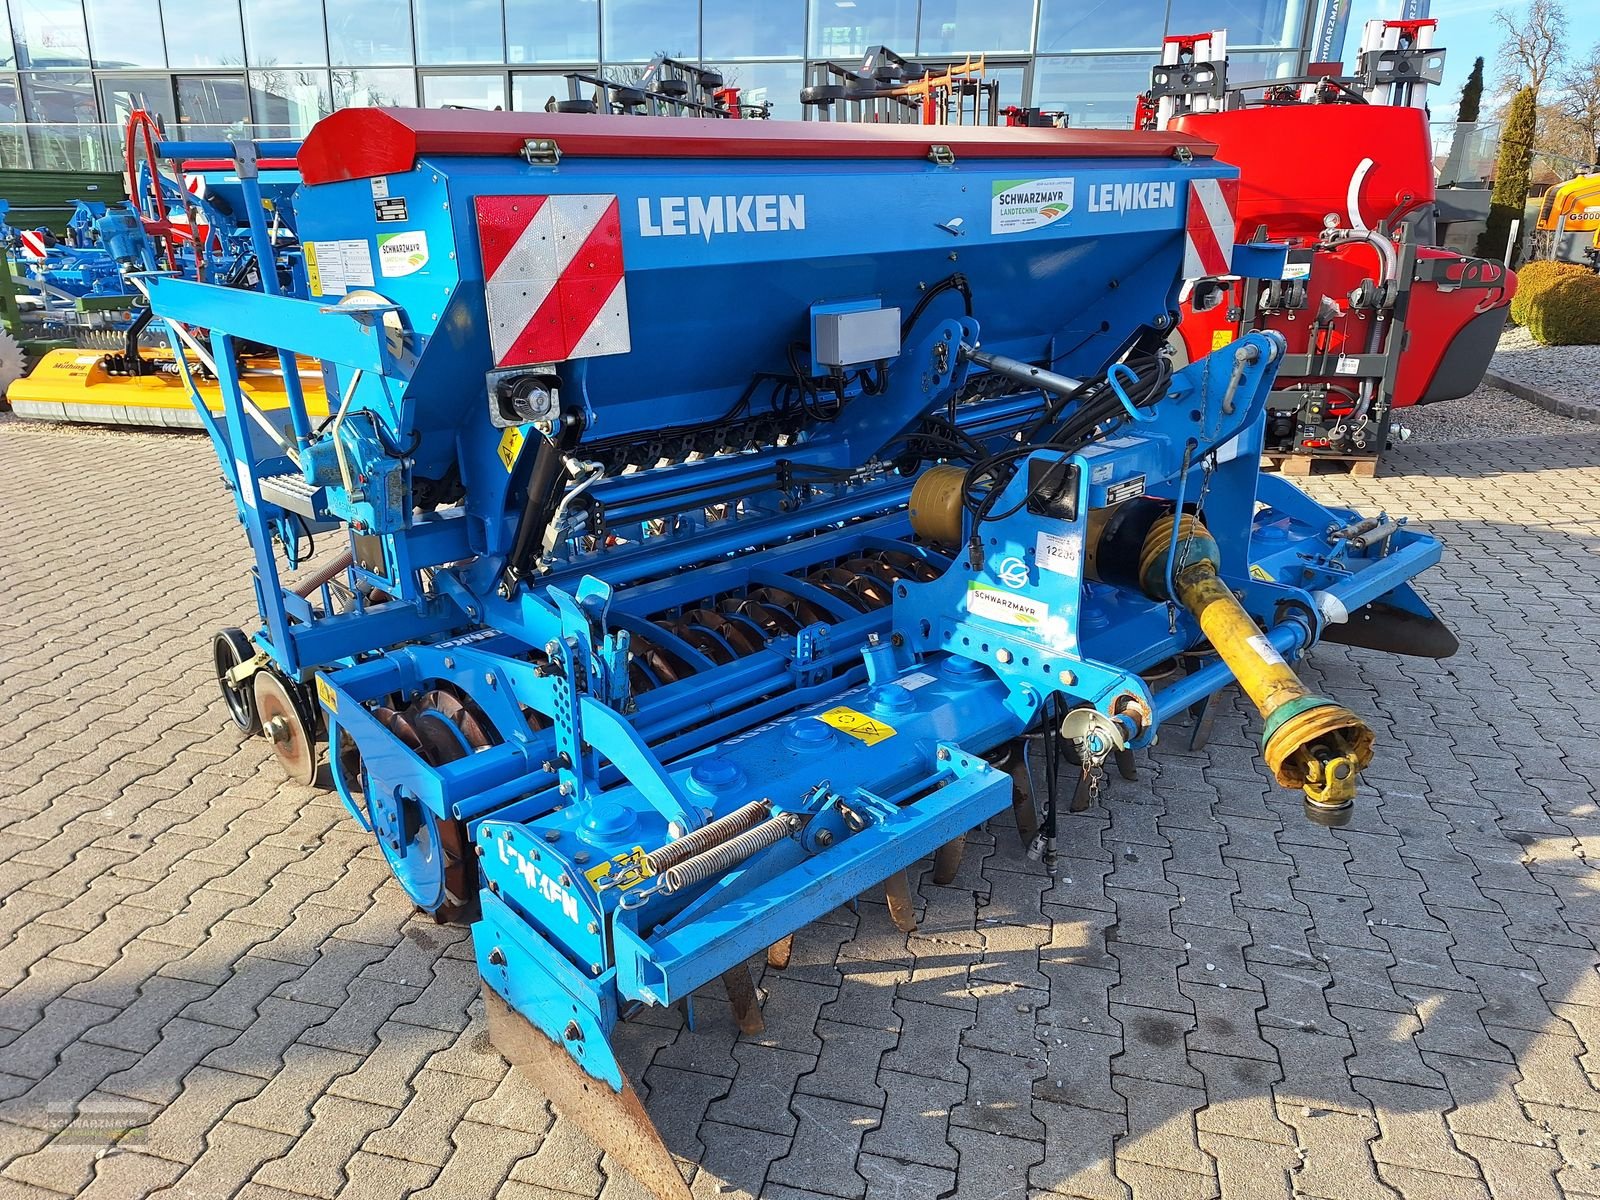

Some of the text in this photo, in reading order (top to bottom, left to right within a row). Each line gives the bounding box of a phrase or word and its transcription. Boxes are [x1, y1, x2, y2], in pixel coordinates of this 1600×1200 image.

[999, 191, 1064, 205] SCHWARZMAYR
[1088, 181, 1176, 218] LEMKEN
[1000, 207, 1039, 216] LANDTECHNIK
[638, 195, 806, 244] LEMKEN
[382, 243, 420, 254] SCHWARZMAYR
[53, 361, 87, 371] Müthing
[975, 590, 1036, 616] SCHWARZMAYR
